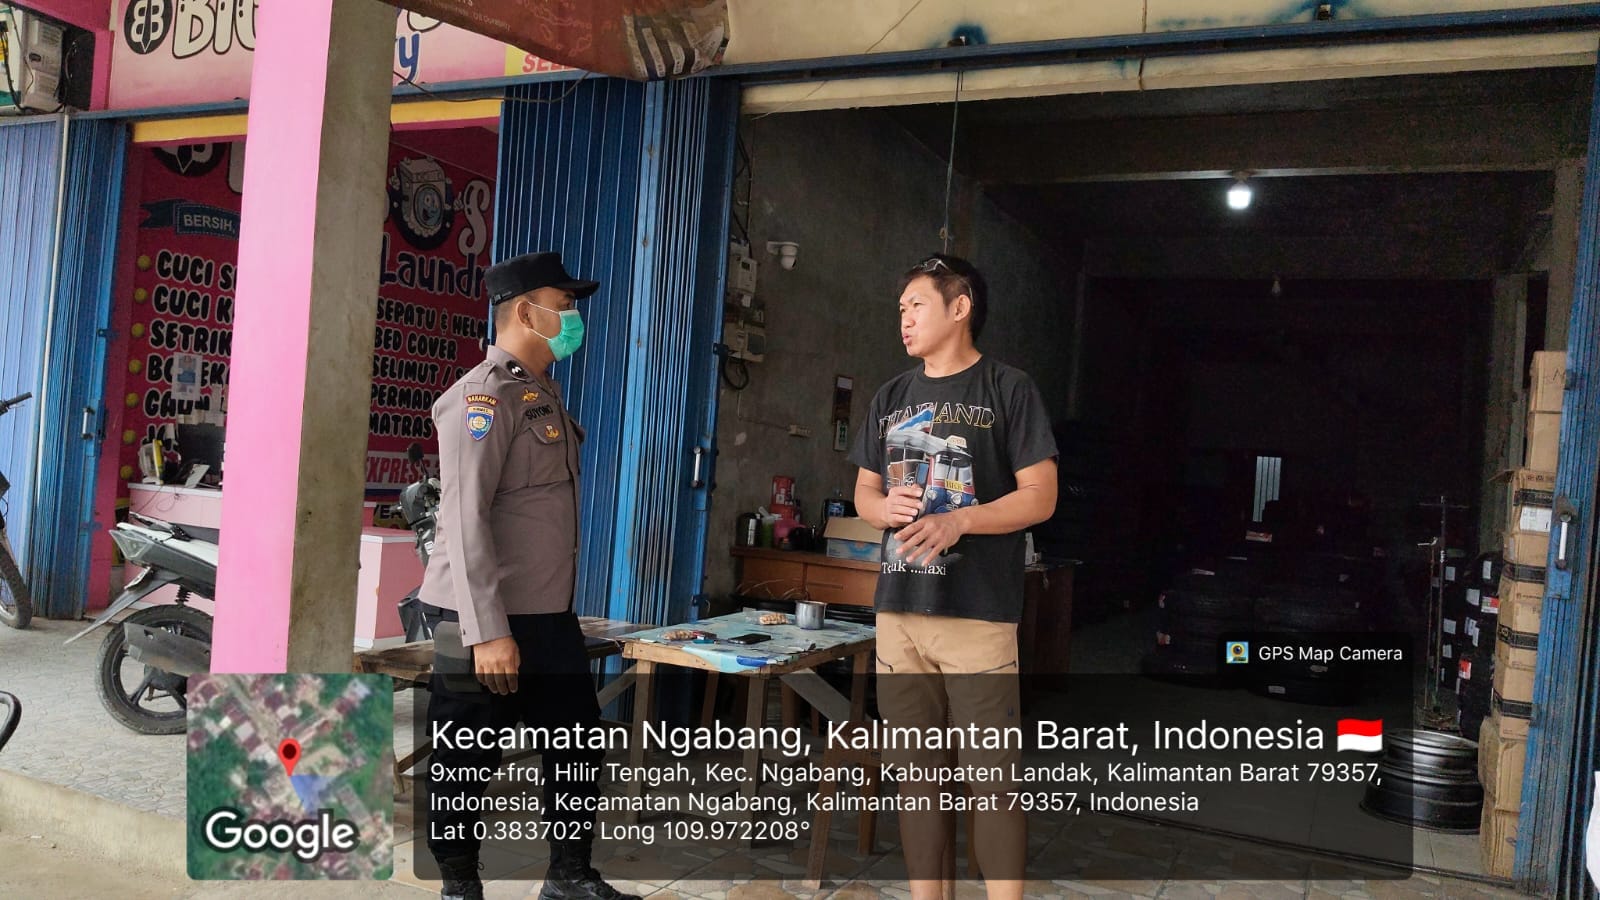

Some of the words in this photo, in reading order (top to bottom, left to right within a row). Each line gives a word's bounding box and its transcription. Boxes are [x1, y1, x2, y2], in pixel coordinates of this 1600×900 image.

[183, 214, 236, 234] BERSIH,
[156, 249, 214, 288] CUCI
[218, 262, 238, 293] S
[380, 232, 486, 299] Laundr
[153, 283, 211, 321] CUCI
[216, 295, 235, 326] K
[376, 297, 436, 330] SEPATU
[149, 318, 232, 358] SETRIK
[374, 326, 402, 352] BED
[407, 331, 457, 361] COVER
[372, 354, 439, 386] SELIMUT
[370, 411, 434, 440] MATRAS
